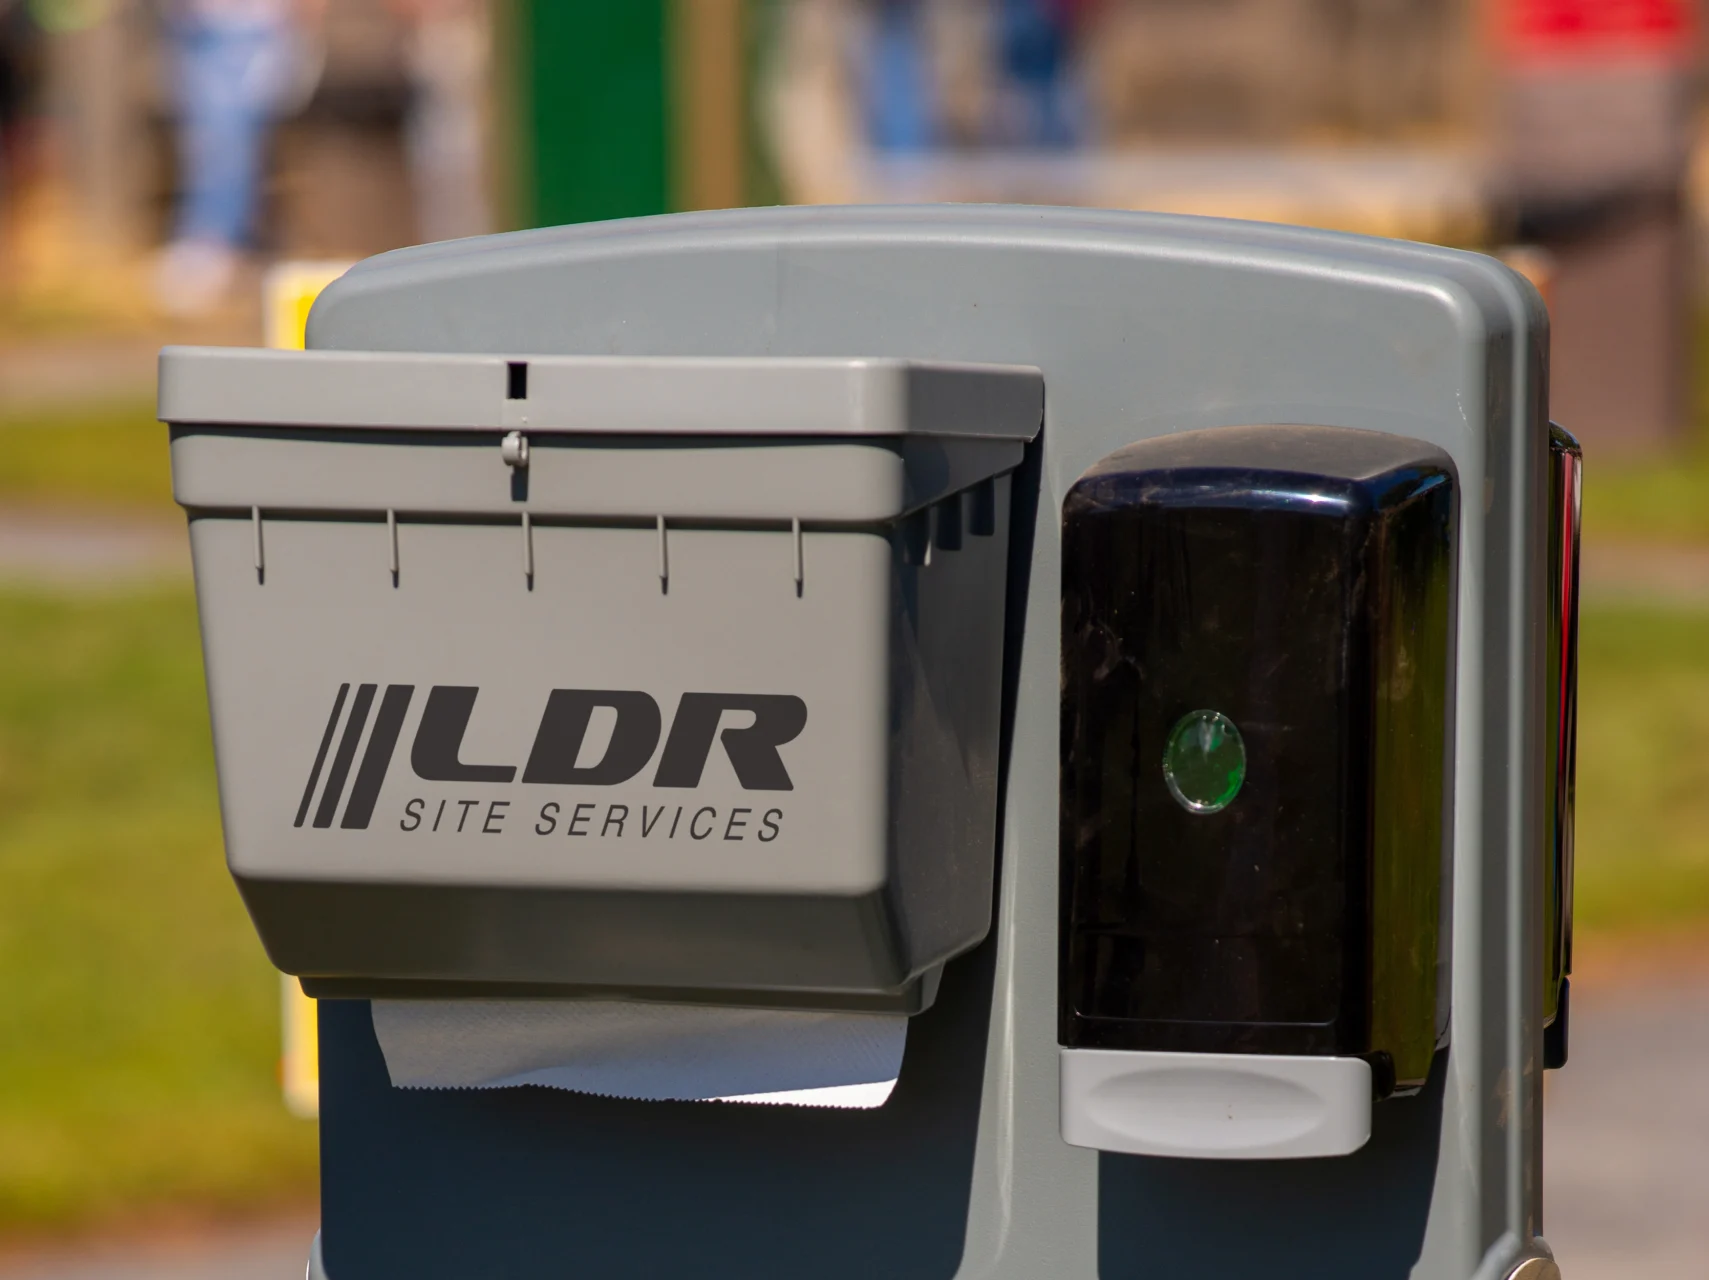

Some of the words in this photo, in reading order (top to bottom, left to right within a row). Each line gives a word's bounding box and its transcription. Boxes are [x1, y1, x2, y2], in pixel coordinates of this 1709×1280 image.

[410, 685, 808, 791] LDR
[400, 798, 511, 834] SITE
[534, 802, 785, 843] SERVICES
